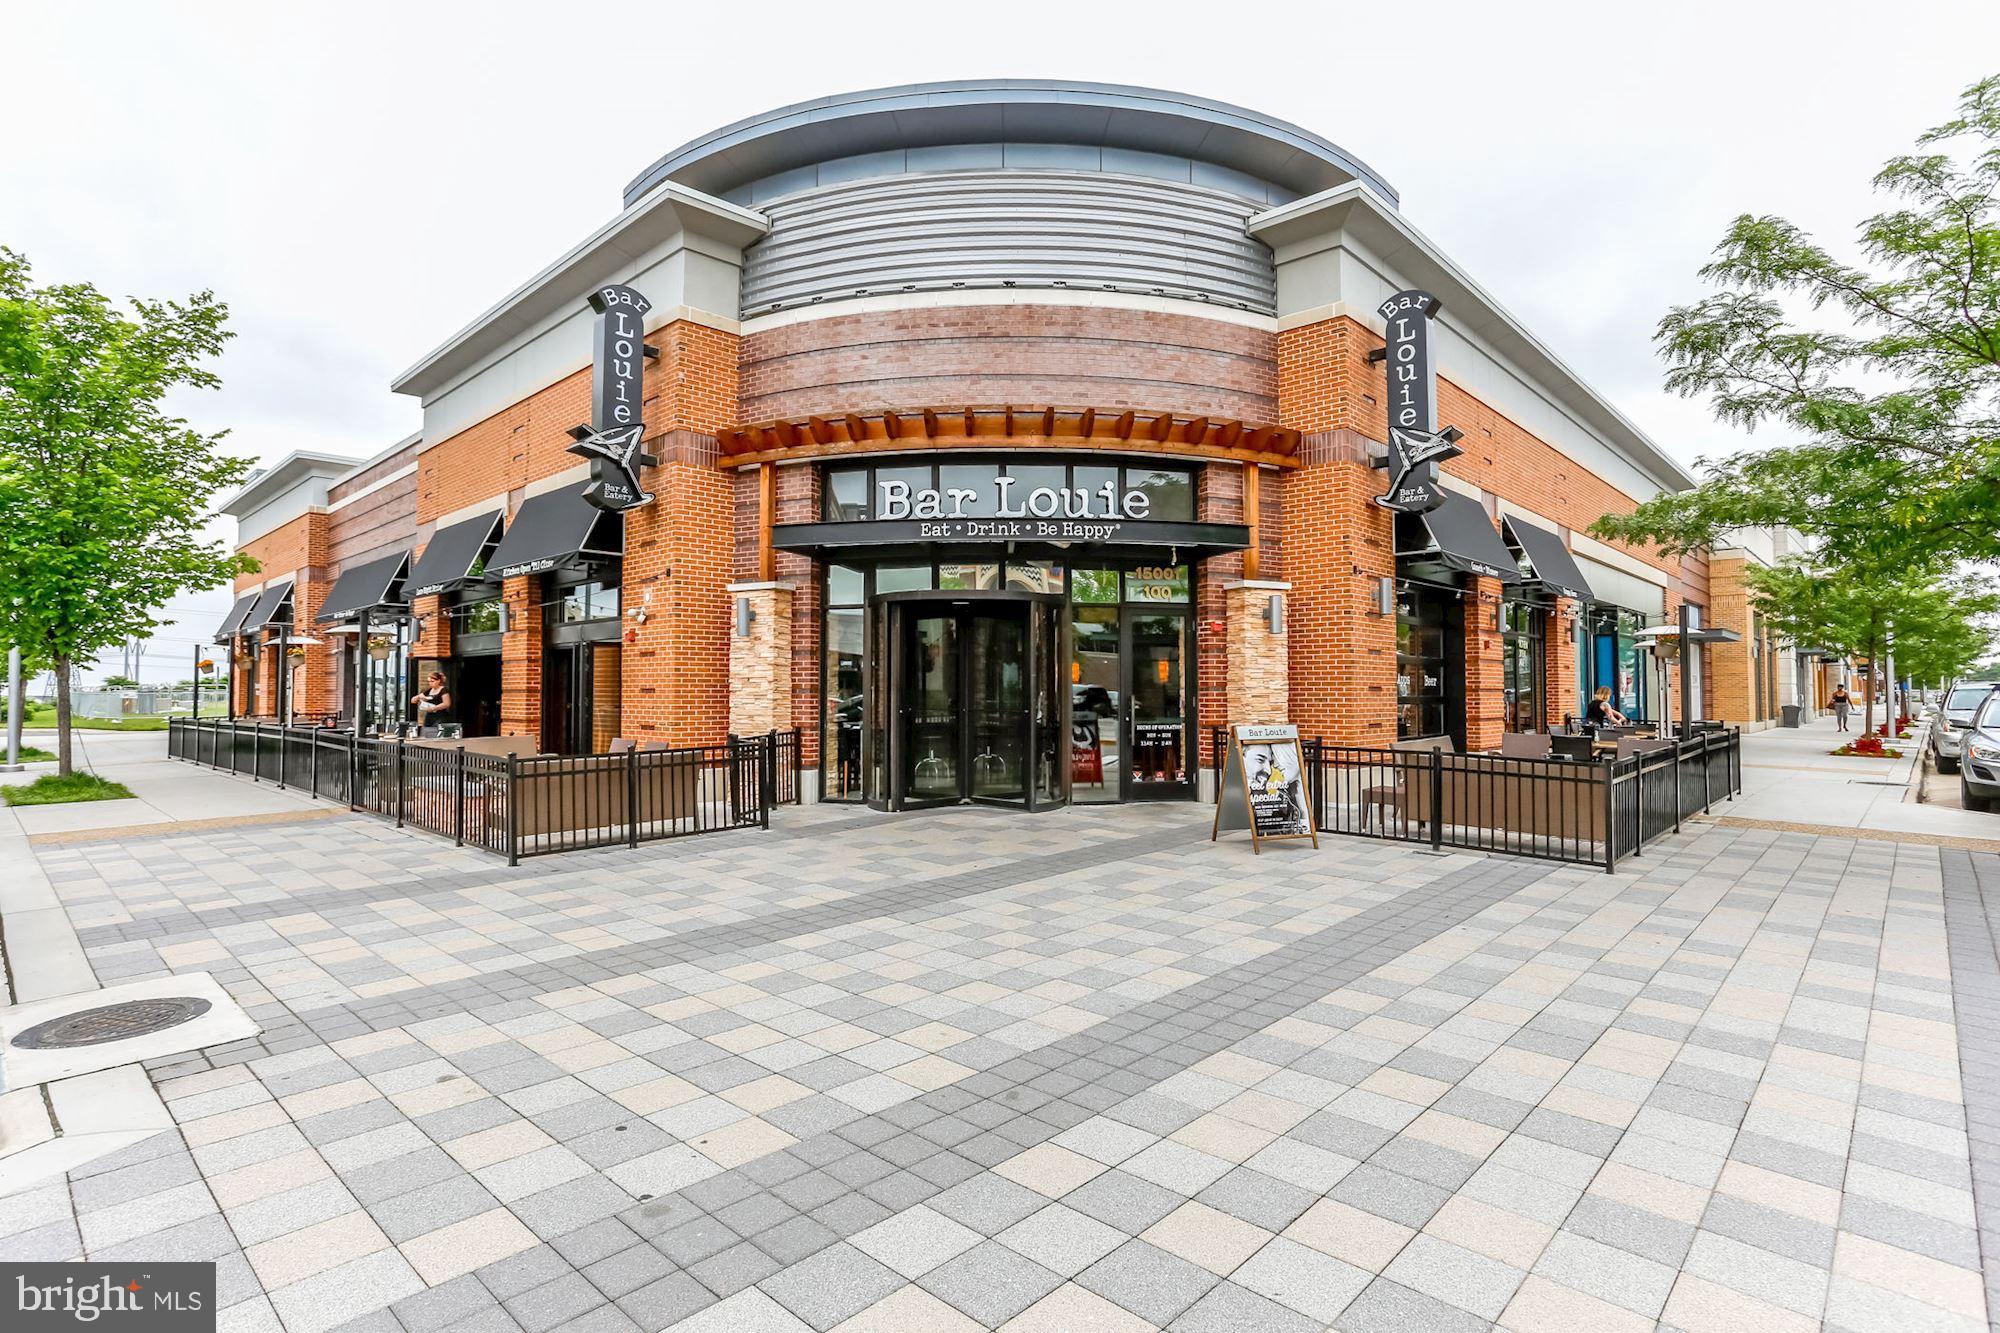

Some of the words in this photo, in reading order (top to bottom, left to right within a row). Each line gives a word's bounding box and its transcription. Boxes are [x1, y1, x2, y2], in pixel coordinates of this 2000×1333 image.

[602, 288, 649, 313] Bar
[1381, 296, 1429, 319] Bar
[613, 312, 634, 423] Louie
[1396, 318, 1418, 427] Louie
[604, 483, 620, 493] Bar
[621, 485, 629, 495] &
[604, 490, 633, 502] Eatery
[1399, 488, 1415, 496] Bar
[1416, 485, 1424, 495] &
[877, 479, 978, 520] Bar
[994, 476, 1150, 519] Louie
[1399, 493, 1429, 504] Eatery
[920, 522, 951, 537] Eat
[966, 522, 1020, 537] Drink
[1037, 522, 1058, 536] Be
[1143, 585, 1171, 599] 100
[1248, 729, 1262, 737] Bar
[1264, 728, 1287, 736] Louie
